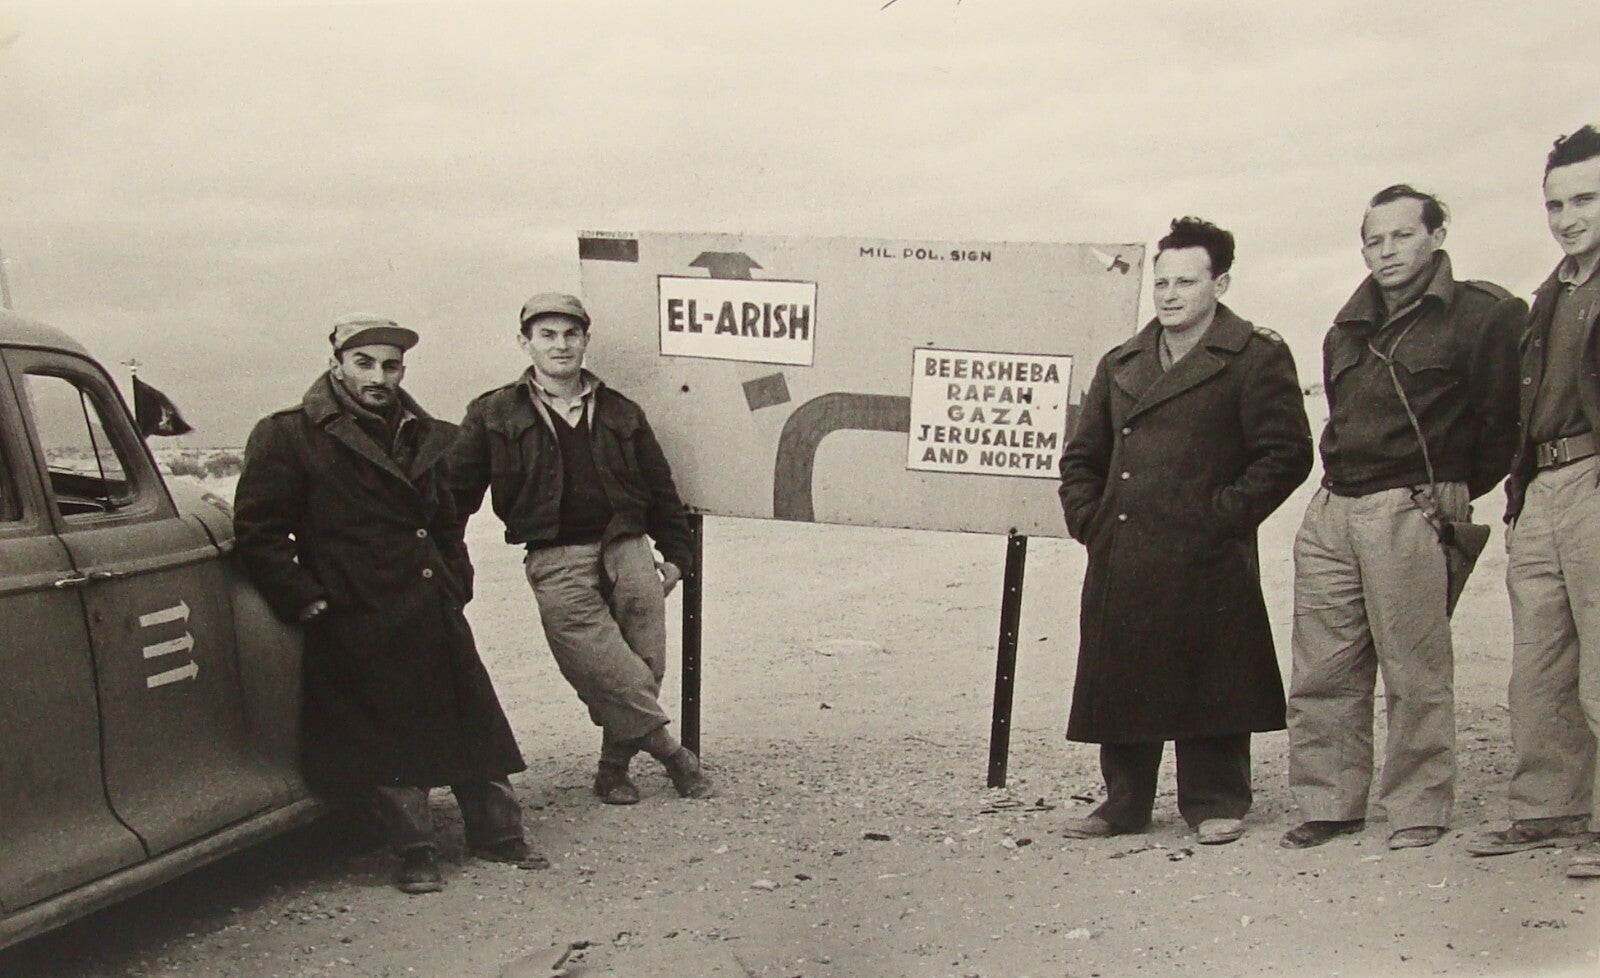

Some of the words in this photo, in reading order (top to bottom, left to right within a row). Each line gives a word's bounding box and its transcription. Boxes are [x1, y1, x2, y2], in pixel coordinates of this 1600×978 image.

[859, 247, 897, 258] MIL.
[903, 248, 944, 260] POL.
[950, 250, 992, 262] SIGN
[667, 298, 810, 340] EL-ARISH
[925, 357, 1060, 384] BEERSHEBA
[947, 383, 1034, 405] RAFAH
[947, 404, 1033, 426] GAZA
[917, 424, 1057, 450] JERUSALEM
[921, 447, 969, 465] AND
[979, 451, 1053, 471] NORTH
